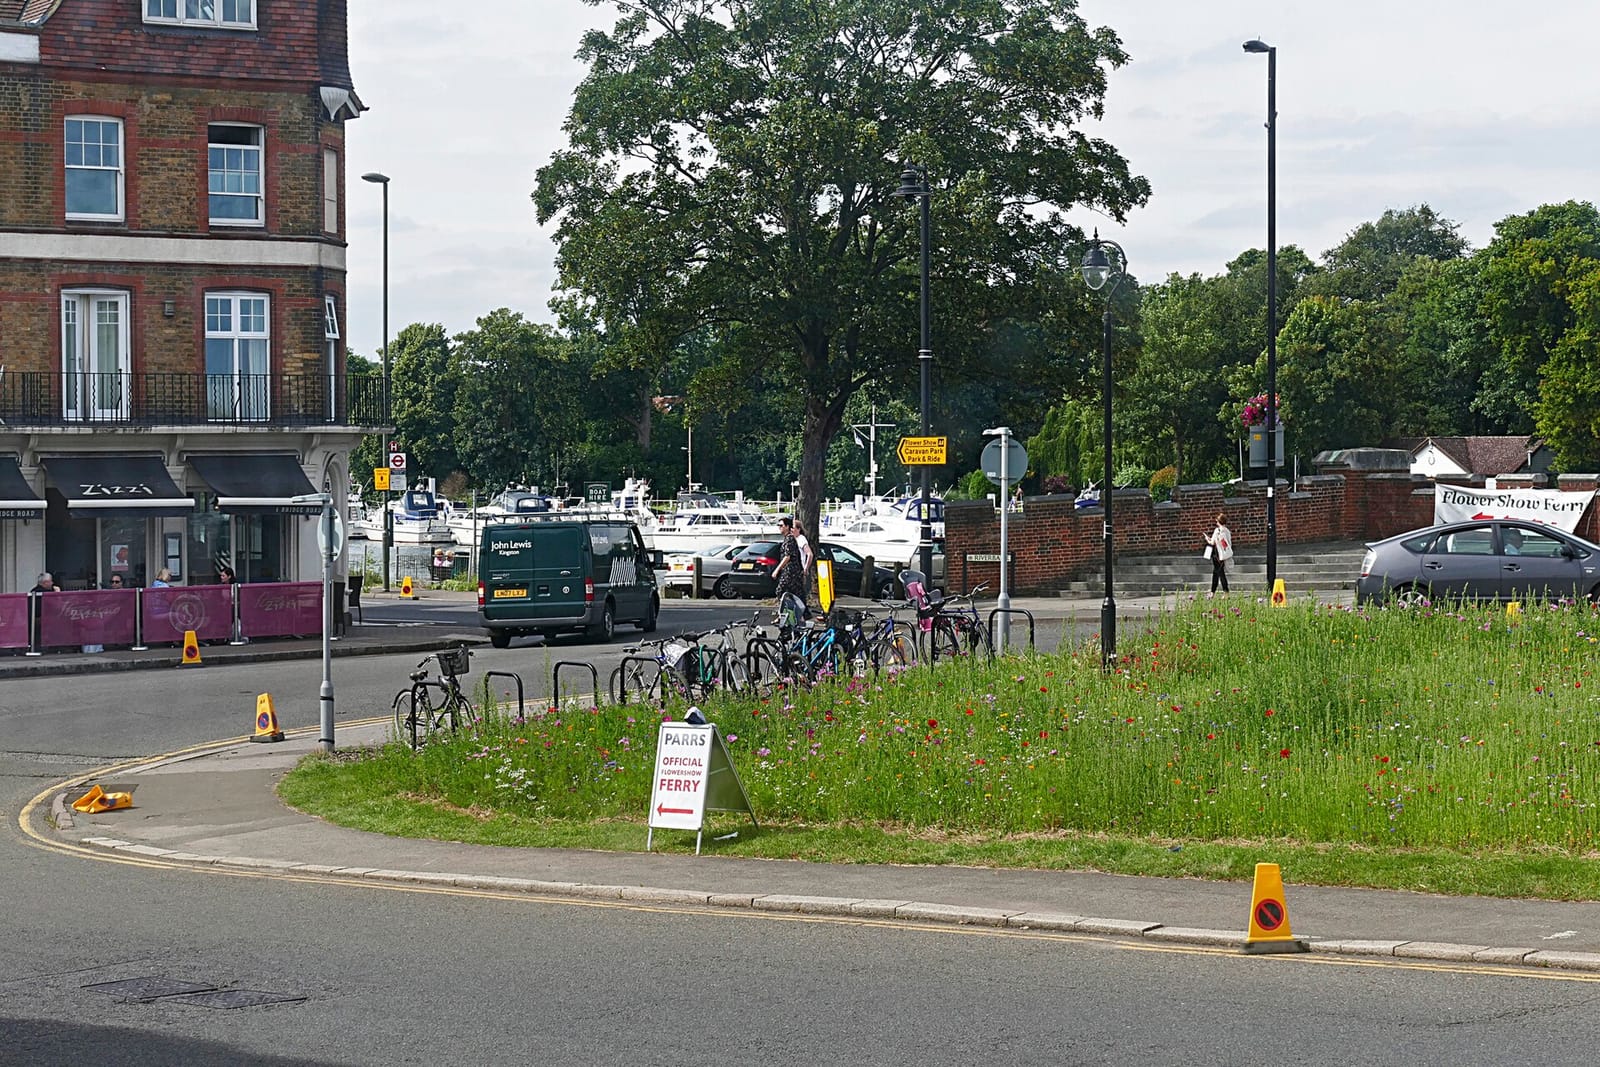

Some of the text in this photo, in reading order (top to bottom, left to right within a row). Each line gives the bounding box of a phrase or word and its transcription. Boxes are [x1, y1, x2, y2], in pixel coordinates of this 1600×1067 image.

[80, 484, 153, 496] Zizzi
[1442, 491, 1495, 507] Flower
[1497, 494, 1540, 510] Show
[491, 540, 532, 552] John Lewis
[665, 733, 706, 746] PARRS
[662, 757, 703, 767] OFFICIAL
[660, 778, 700, 792] FERRY
